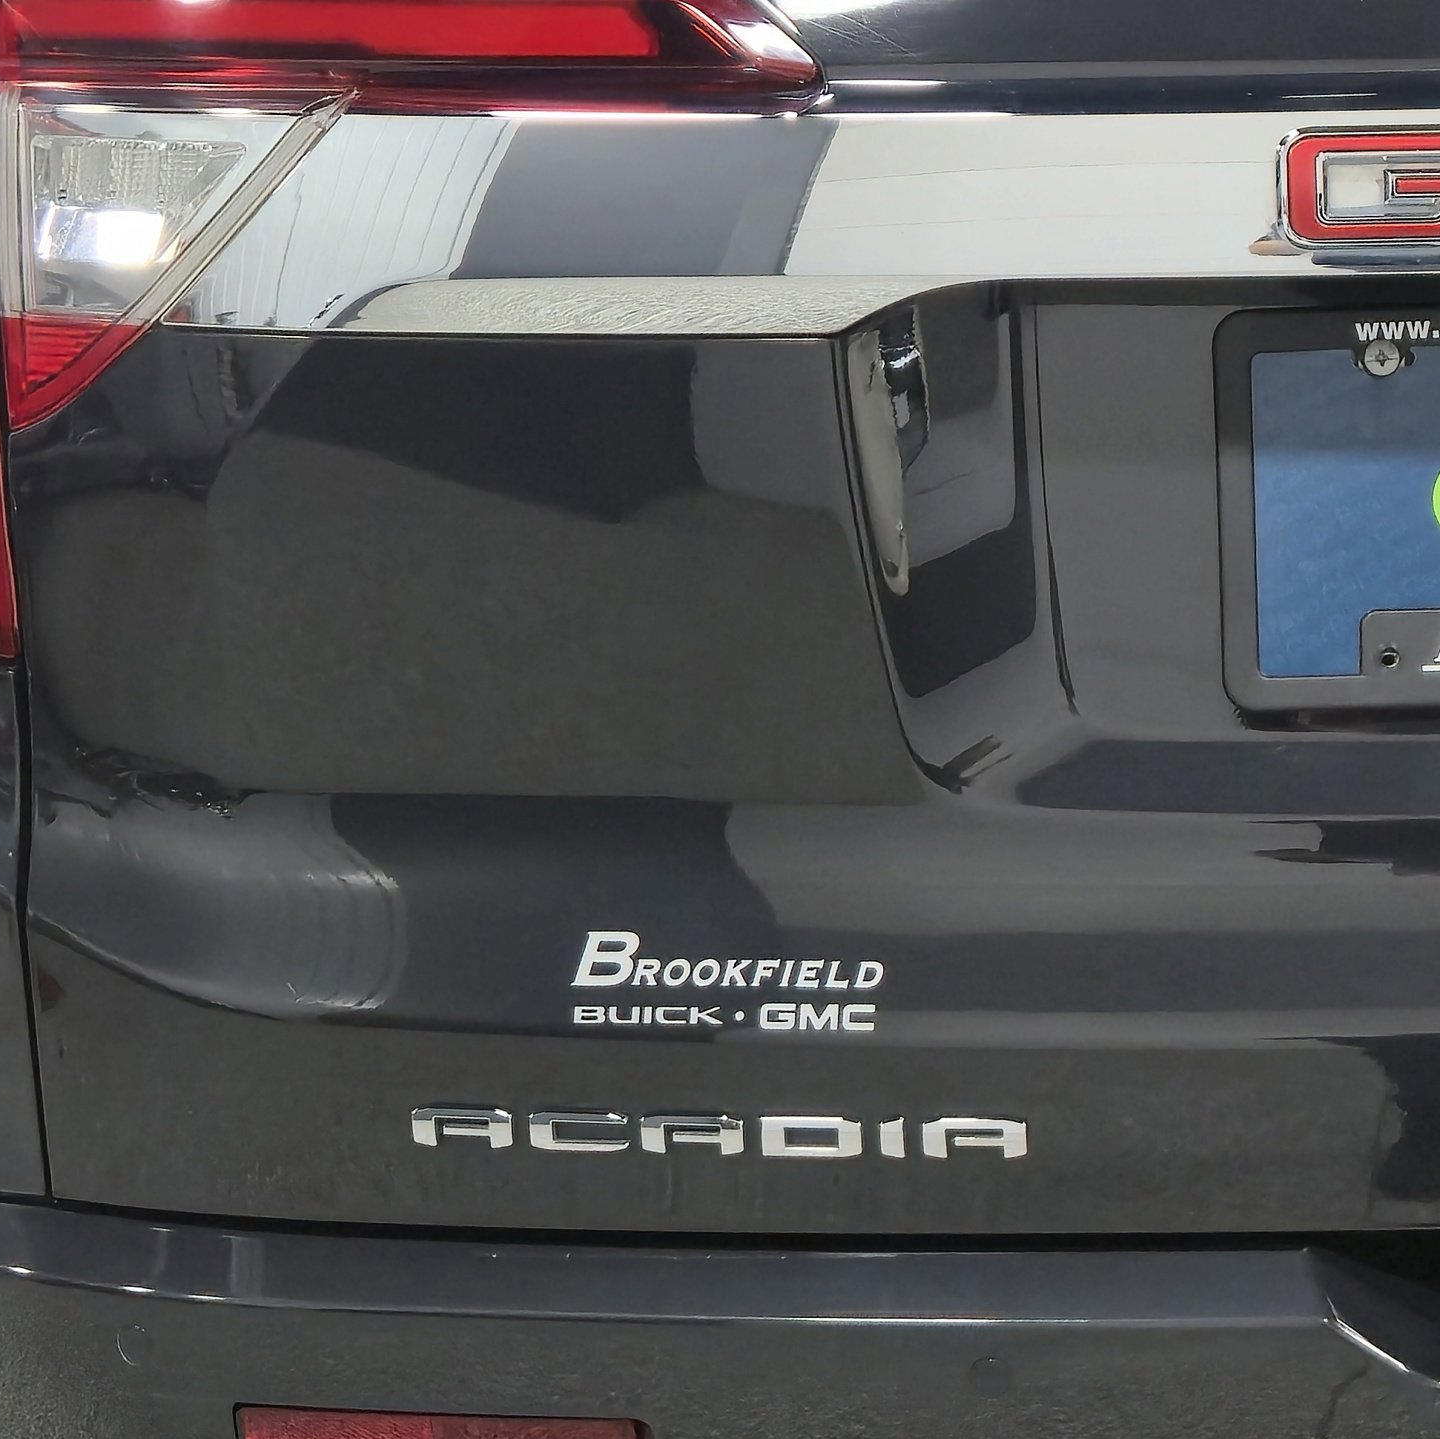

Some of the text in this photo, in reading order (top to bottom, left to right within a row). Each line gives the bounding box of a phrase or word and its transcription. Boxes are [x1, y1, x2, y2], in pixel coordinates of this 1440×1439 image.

[570, 930, 885, 990] BROOKFIELD
[572, 1002, 877, 1032] BUICK GMC
[410, 1105, 1029, 1160] ACADIA
